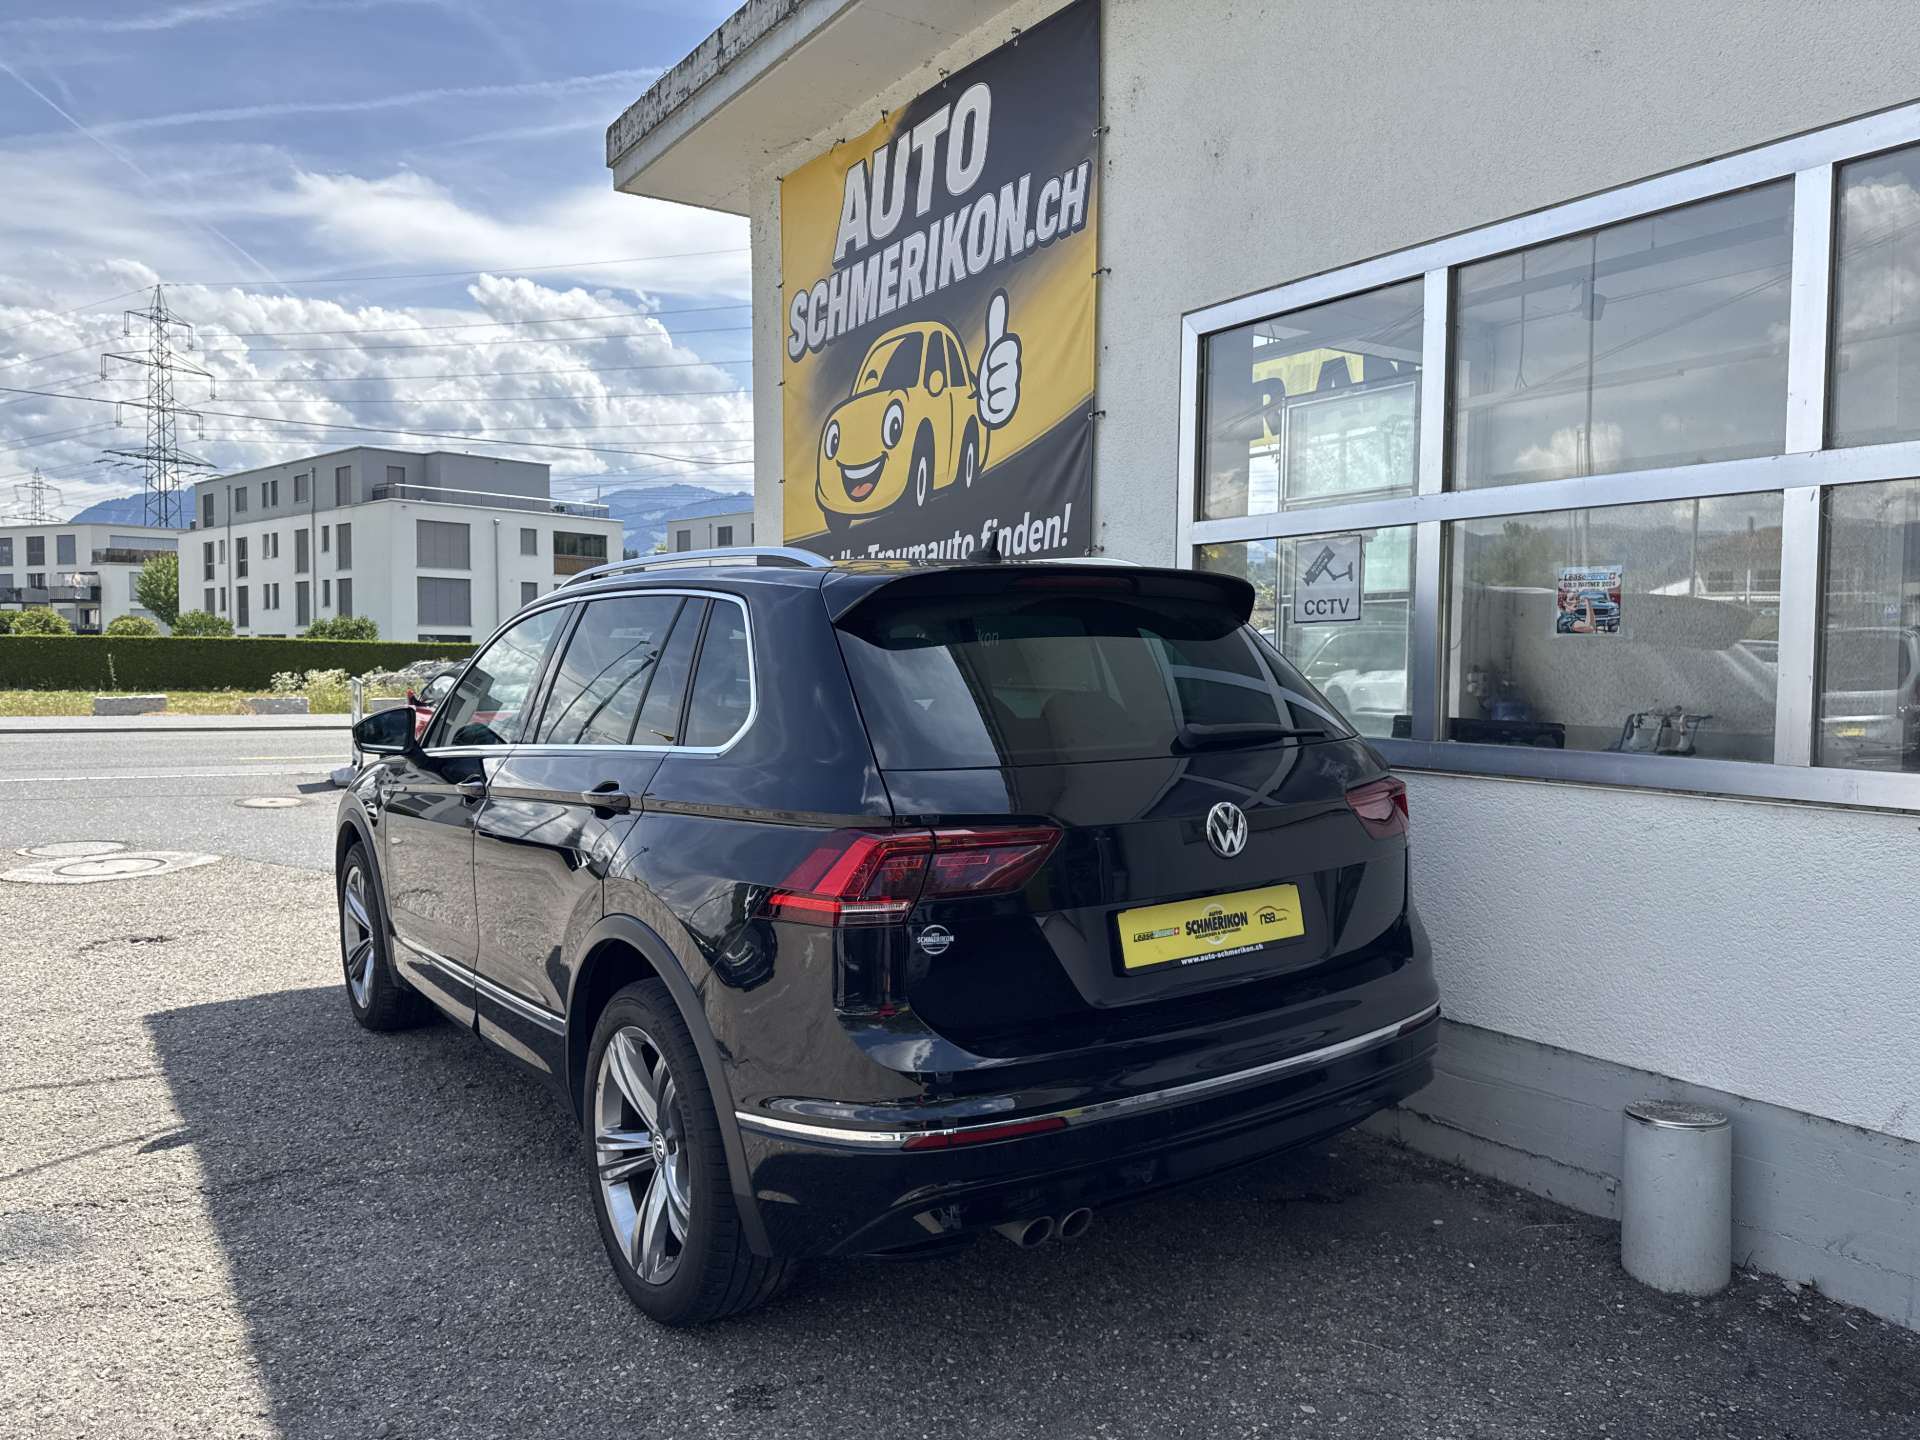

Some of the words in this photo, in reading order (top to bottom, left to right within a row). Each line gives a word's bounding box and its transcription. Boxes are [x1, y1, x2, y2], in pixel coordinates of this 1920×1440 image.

[832, 81, 992, 265] AUTO
[787, 160, 1091, 357] SCHMERIKON.CH
[980, 502, 1072, 556] fnden!
[1304, 597, 1350, 616] CCTV
[1185, 911, 1249, 936] SCHMERIKON
[1180, 943, 1264, 965] www.auto-schmerikon.ch
